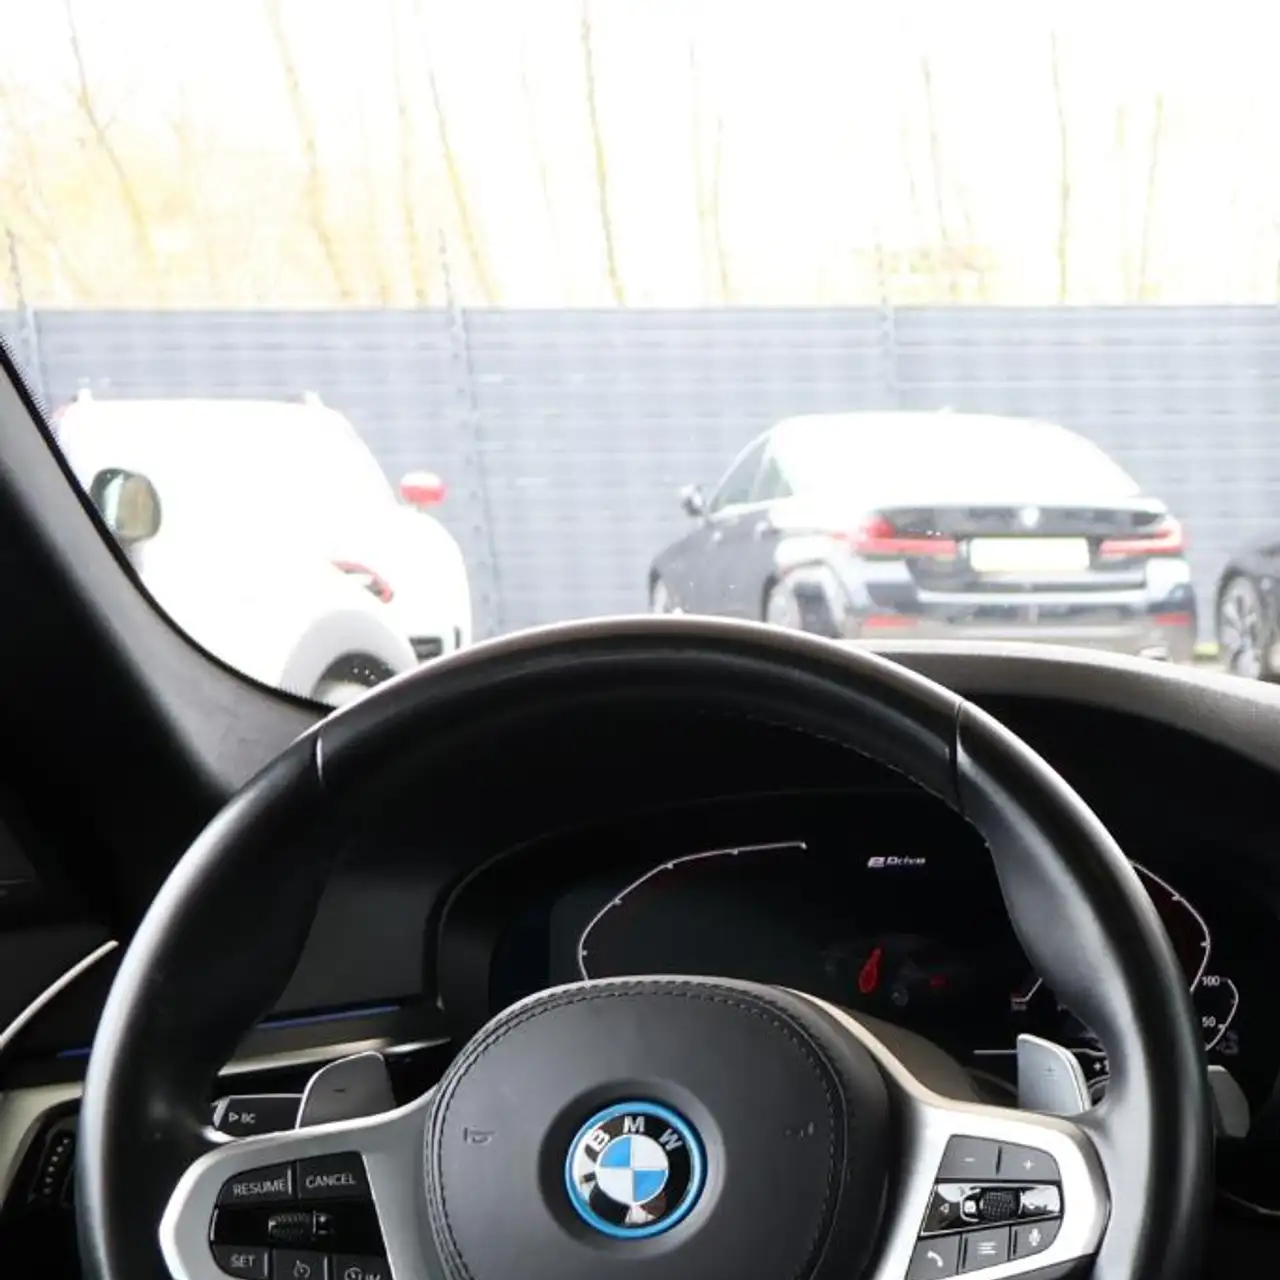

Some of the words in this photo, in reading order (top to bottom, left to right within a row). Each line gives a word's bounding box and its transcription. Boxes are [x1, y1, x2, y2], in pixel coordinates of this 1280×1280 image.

[1202, 975, 1220, 987] 100
[1202, 1016, 1216, 1028] 50
[588, 1115, 684, 1151] BMW
[233, 1179, 287, 1196] RESUME
[305, 1173, 356, 1189] CANCEL
[230, 1255, 256, 1268] SET
